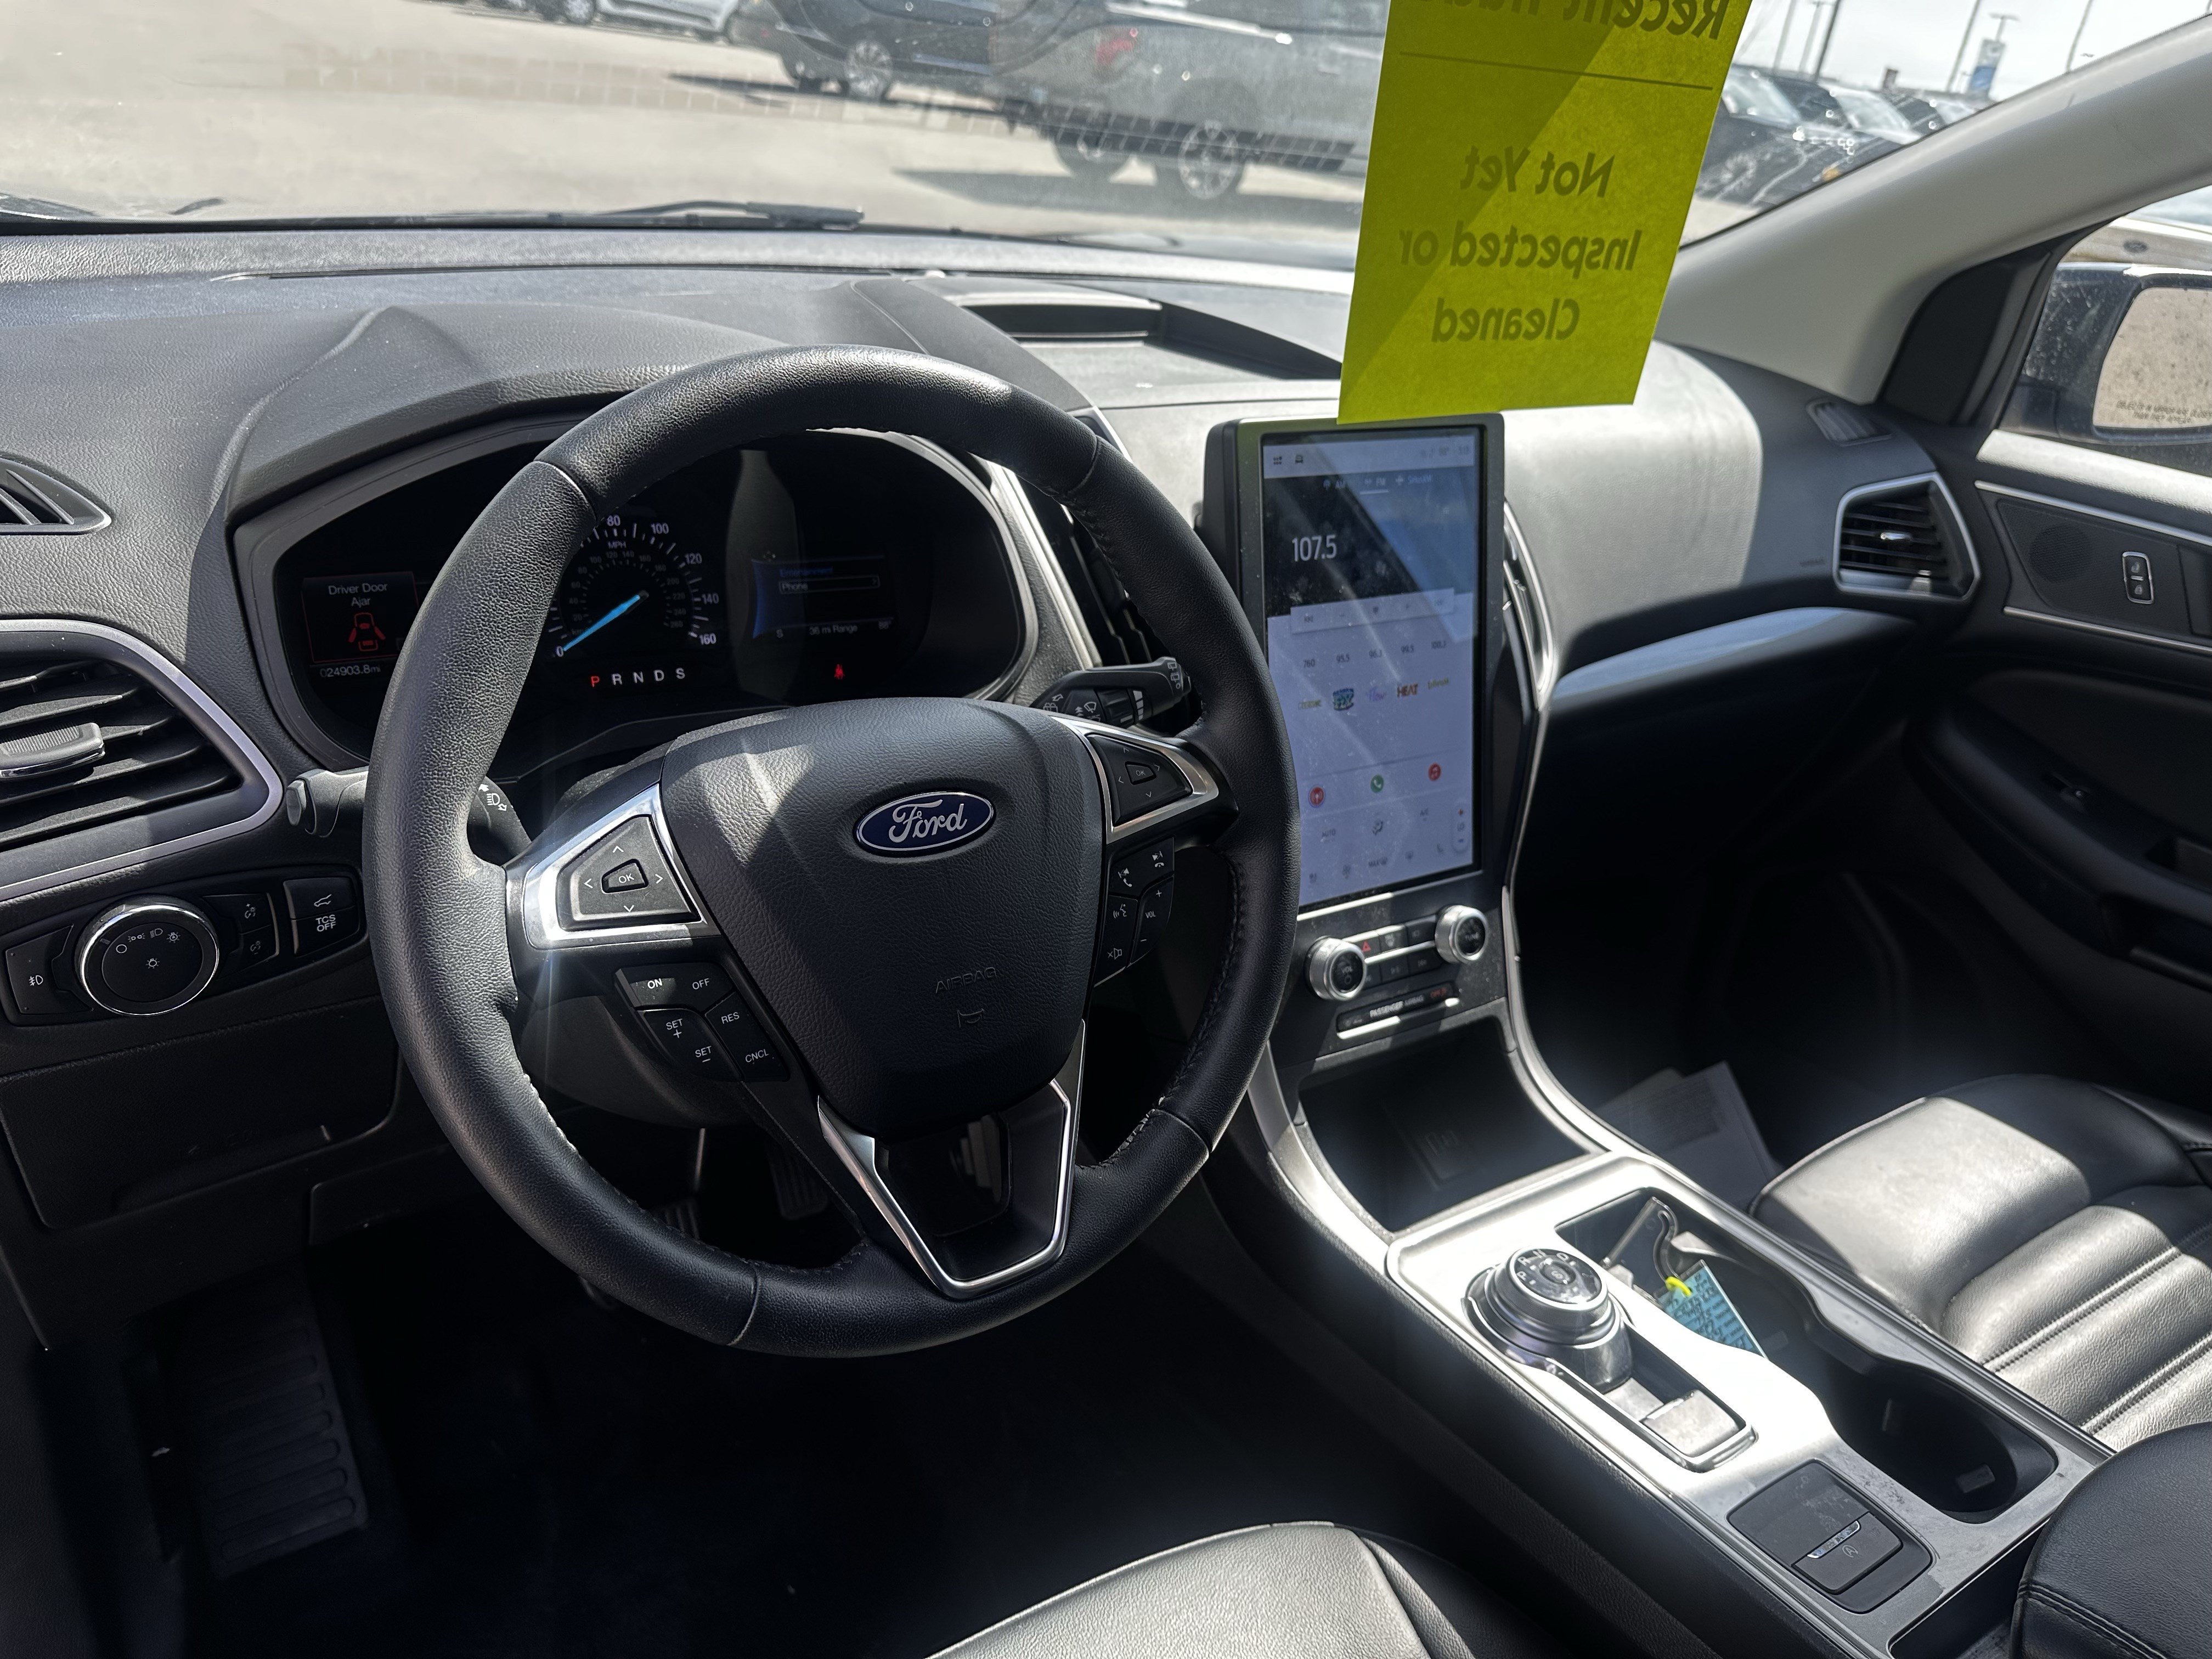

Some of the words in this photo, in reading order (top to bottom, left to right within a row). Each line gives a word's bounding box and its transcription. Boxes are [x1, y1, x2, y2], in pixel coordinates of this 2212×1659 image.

[607, 515, 621, 527] 80
[651, 522, 669, 534] 100
[607, 540, 627, 549] MPH
[1291, 534, 1338, 562] 107.5
[685, 553, 702, 565] 120
[328, 585, 360, 595] Driver
[362, 583, 388, 593] Door
[351, 596, 371, 607] Ajar
[702, 593, 719, 605] 140
[832, 624, 859, 635] Range
[699, 633, 716, 645] 160
[556, 646, 563, 657] 0
[1303, 658, 1316, 668] 760
[591, 676, 600, 687] P
[612, 673, 623, 685] R
[633, 671, 645, 684] N
[653, 669, 665, 681] D
[675, 667, 686, 680] S
[1397, 682, 1419, 698] HEAT
[888, 799, 967, 843] Ford
[1321, 828, 1336, 838] AUTO
[618, 873, 635, 884] OK
[315, 914, 336, 924] TCS
[1145, 911, 1156, 919] VOL
[317, 921, 336, 932] OFF
[647, 978, 662, 990] ON
[692, 978, 710, 990] OFF
[935, 967, 996, 994] AIRBAG
[721, 1012, 740, 1024] RES
[666, 1019, 683, 1030] SET
[695, 1045, 712, 1058] SET
[745, 1049, 770, 1063] CNCL
[1517, 1256, 1532, 1267] R
[1556, 1252, 1570, 1262] D
[1516, 1271, 1527, 1281] P
